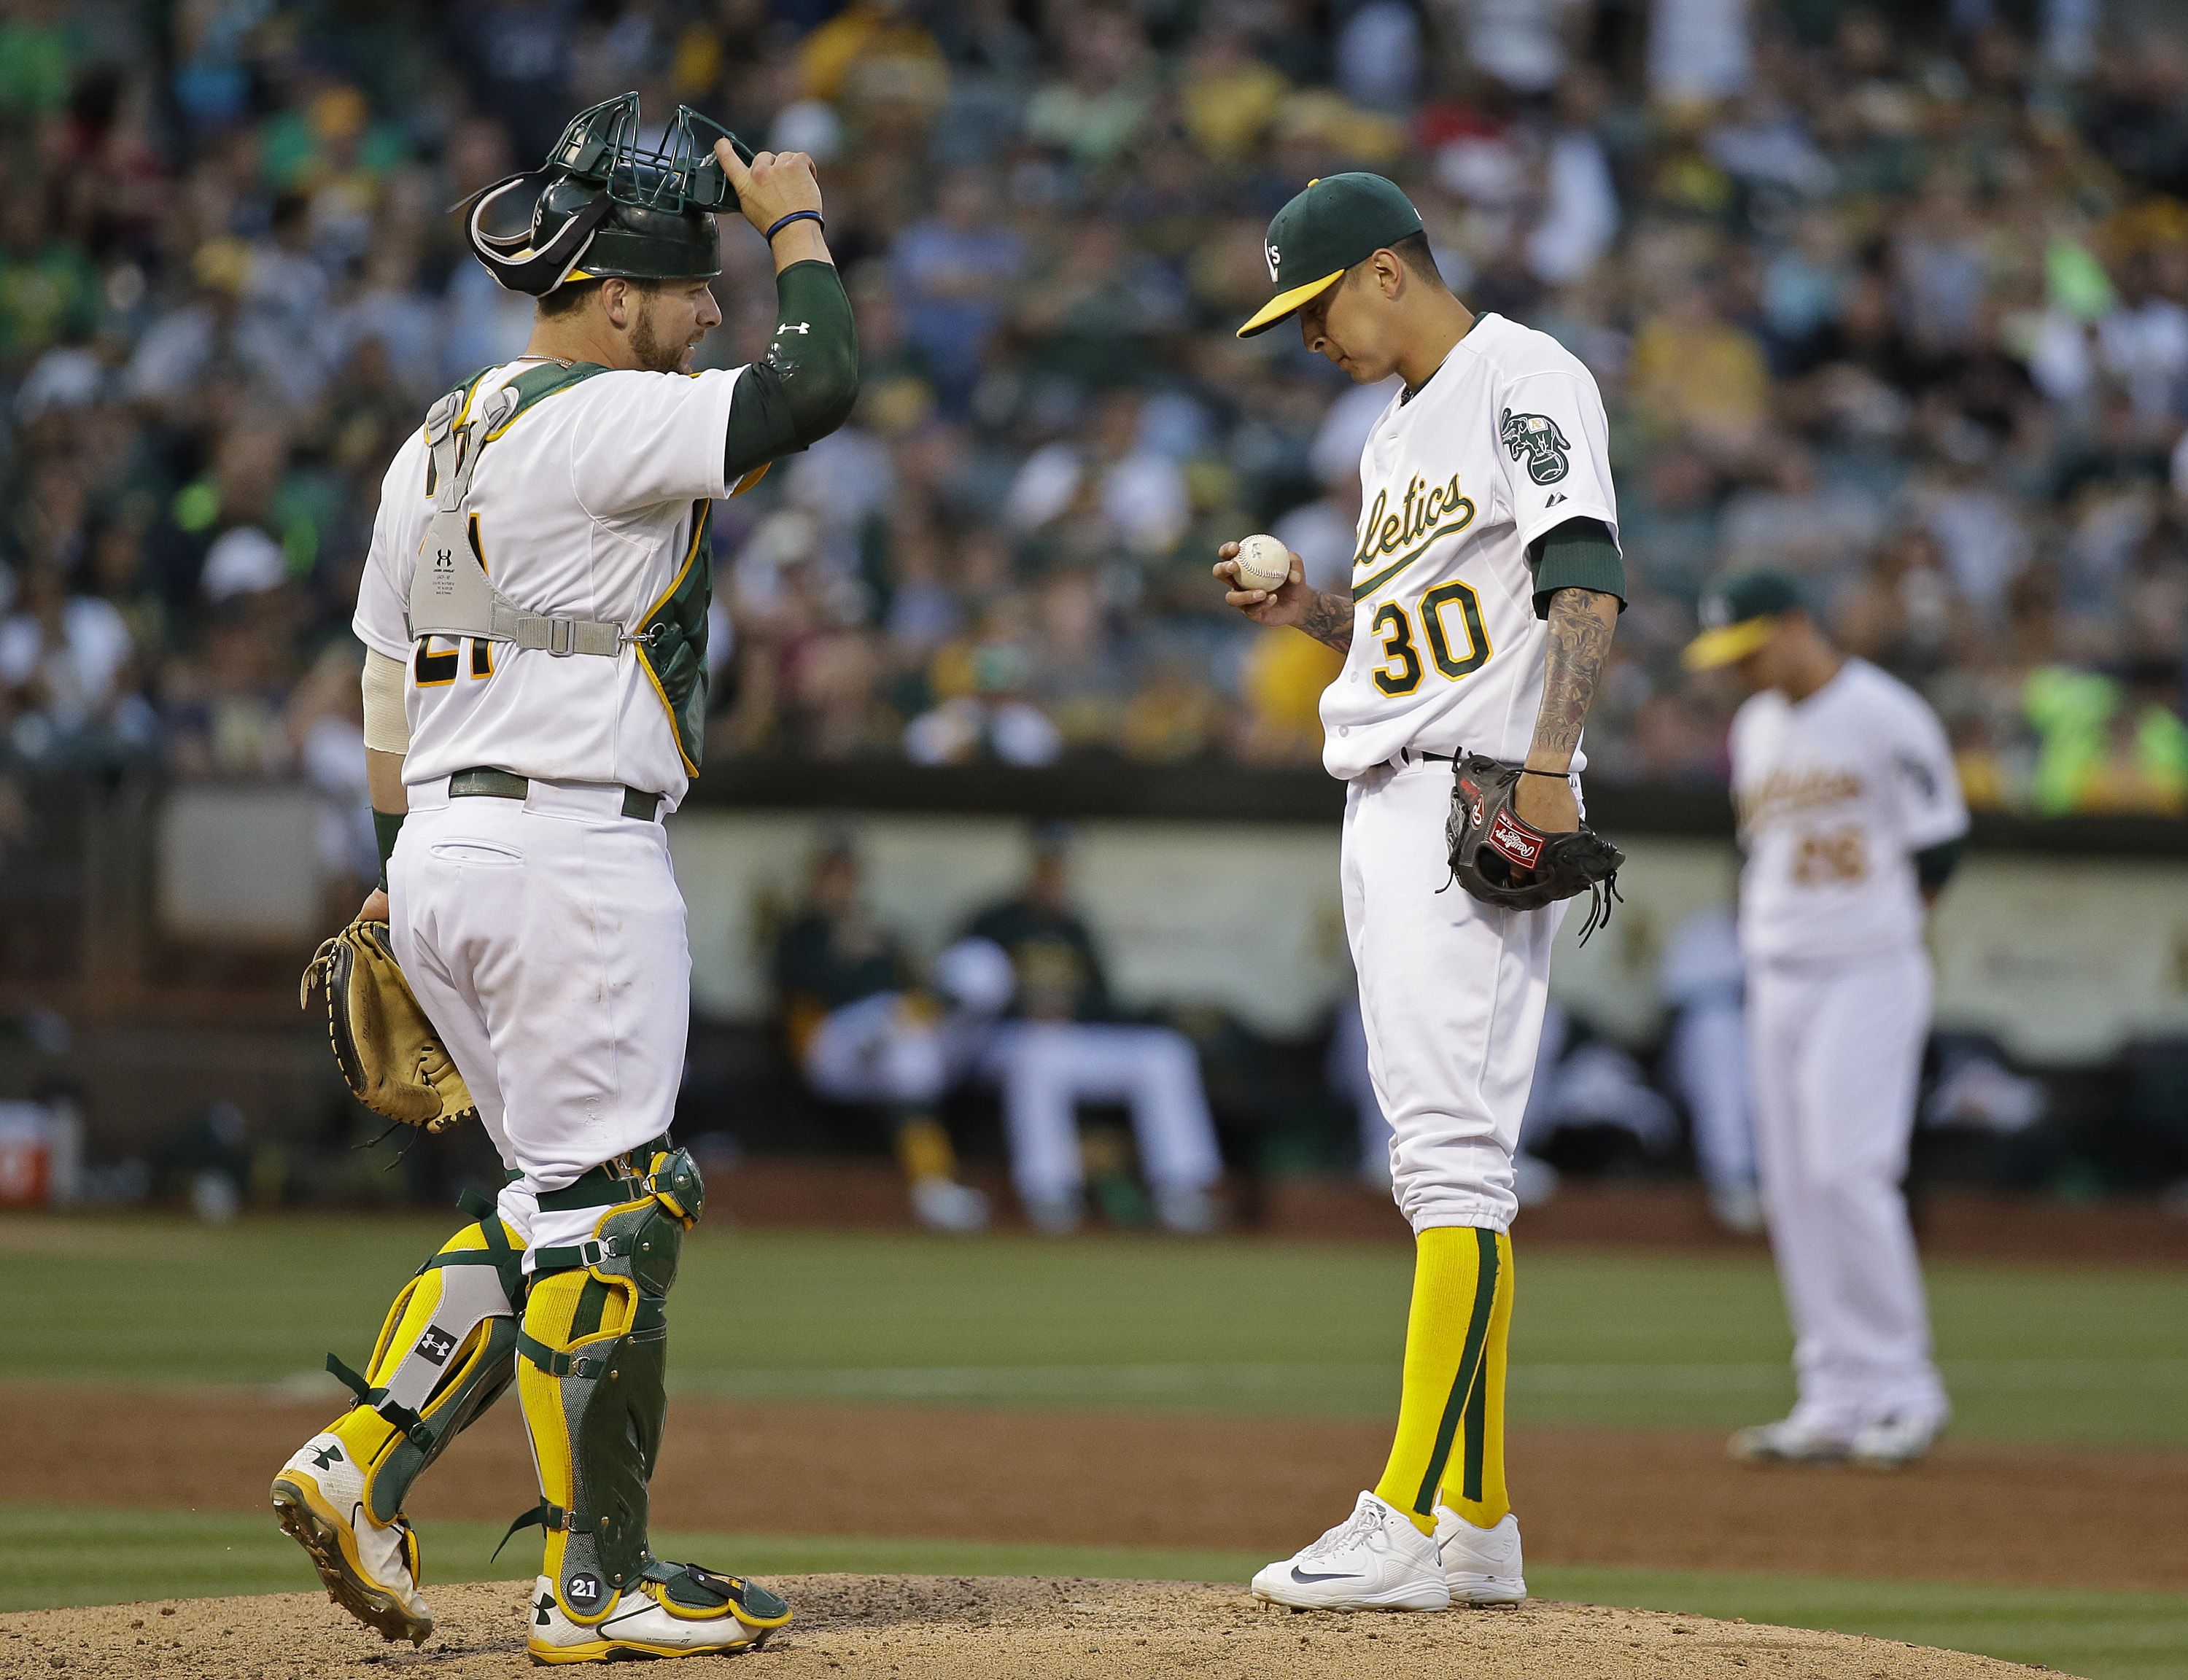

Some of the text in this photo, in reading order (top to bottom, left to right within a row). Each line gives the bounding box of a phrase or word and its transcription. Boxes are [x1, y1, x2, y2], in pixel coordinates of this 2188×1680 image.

[1352, 468, 1476, 567] letics
[1371, 580, 1494, 699] 30
[1495, 828, 1535, 857] Rawlings
[571, 1579, 597, 1598] 21
